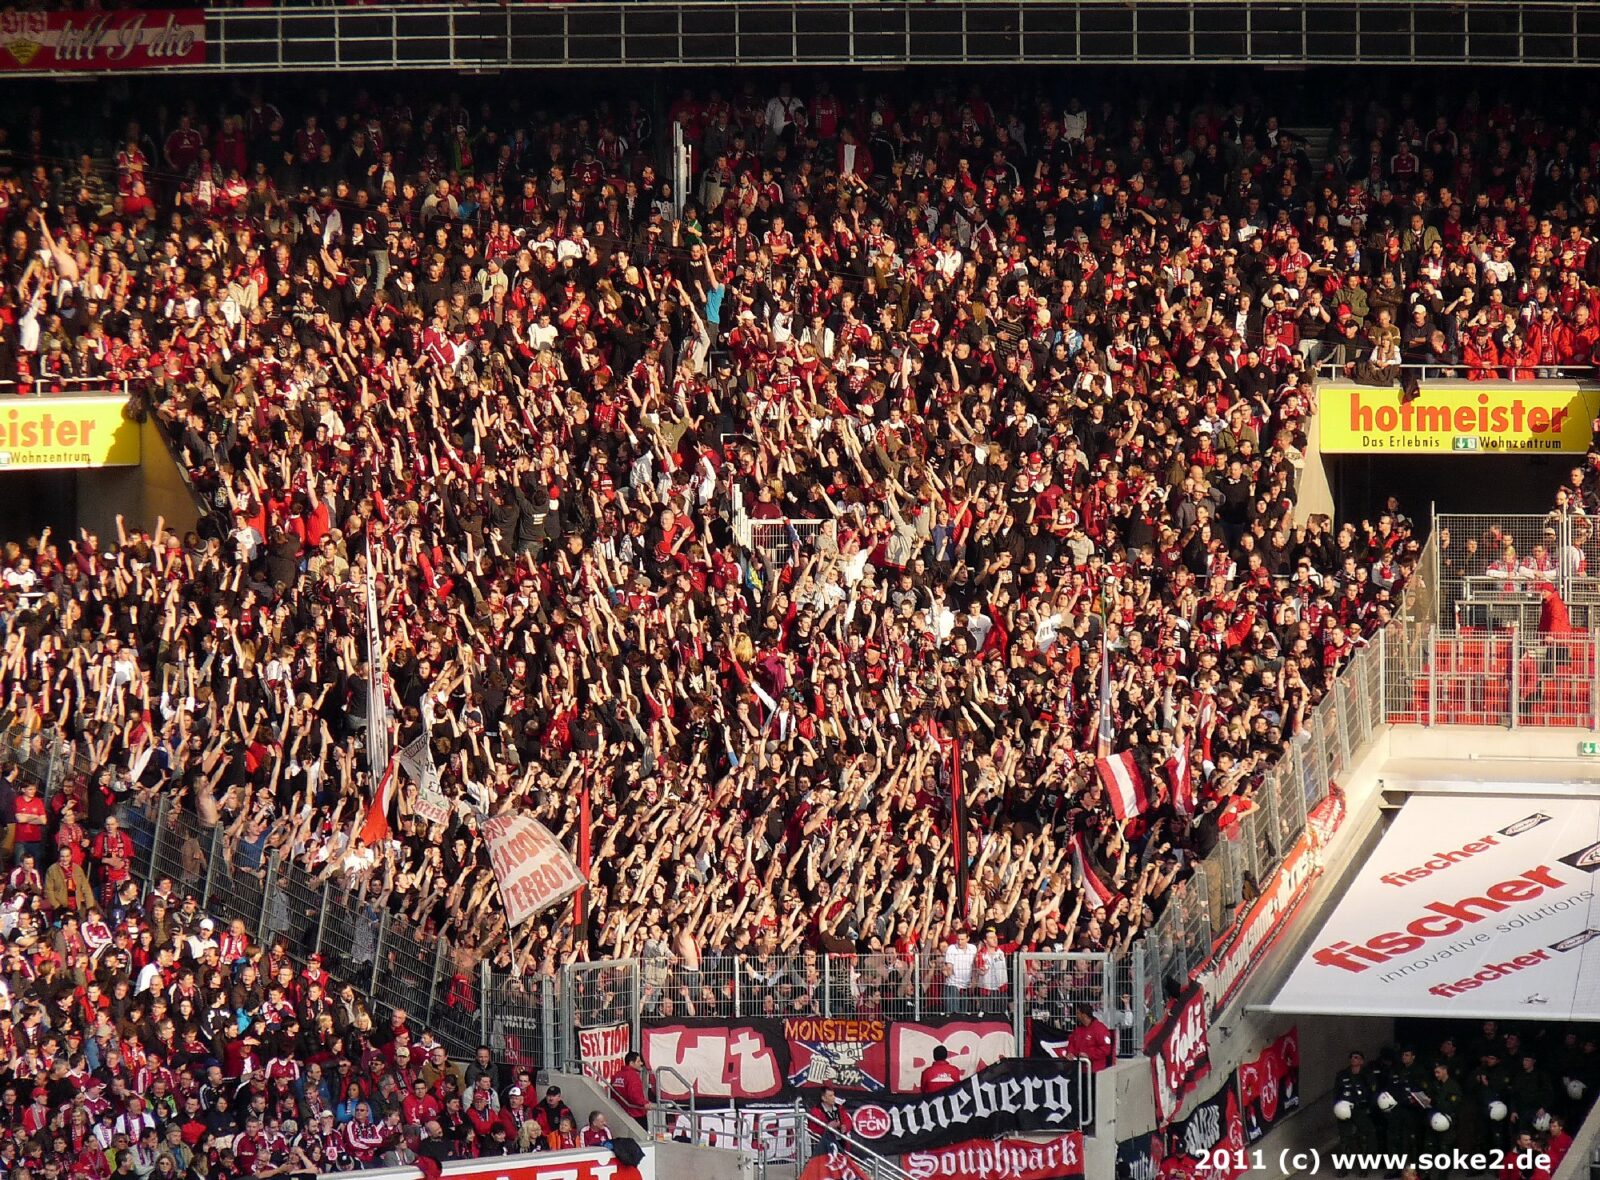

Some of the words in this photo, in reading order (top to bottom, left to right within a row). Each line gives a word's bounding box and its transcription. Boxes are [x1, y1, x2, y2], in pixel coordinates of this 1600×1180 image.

[0, 409, 96, 447] eister
[1350, 393, 1568, 433] hofmeister
[11, 451, 90, 464] Wohnzentrum
[1362, 435, 1384, 447] Das
[1389, 435, 1440, 447] Erlebnis
[1480, 435, 1562, 449] Wohnzentrum
[1380, 835, 1500, 887] fischer
[1312, 864, 1567, 973] fischer
[1379, 931, 1491, 984] innovative
[1496, 890, 1594, 933] solutions
[1428, 949, 1552, 998] fischer
[785, 1018, 885, 1041] MONSTERS
[858, 1120, 887, 1132] FCN
